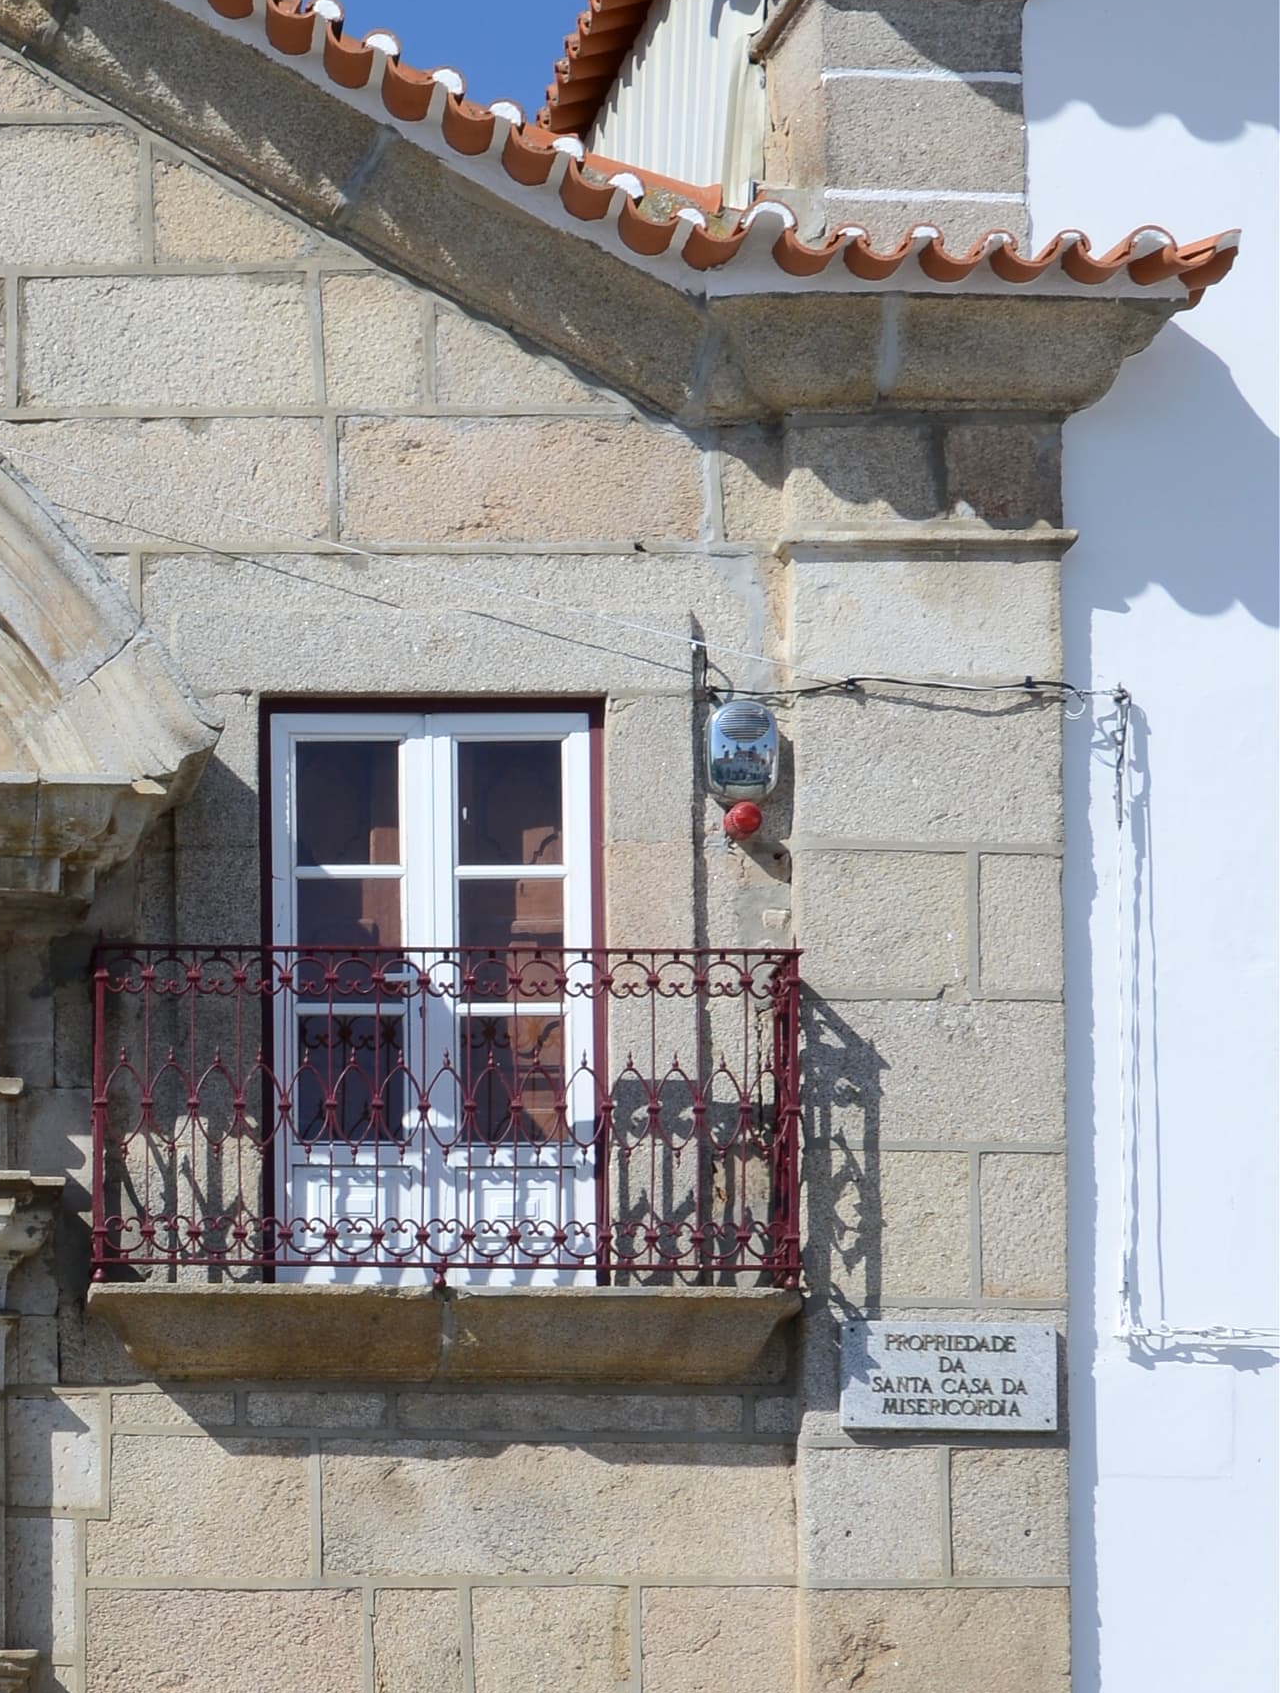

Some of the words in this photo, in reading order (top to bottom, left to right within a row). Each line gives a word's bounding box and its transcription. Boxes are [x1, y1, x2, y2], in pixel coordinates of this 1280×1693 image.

[884, 1334, 1017, 1353] PROPRIEDADE
[939, 1356, 967, 1374] DA
[872, 1376, 934, 1394] SANTA
[941, 1378, 995, 1396] CASA
[1001, 1378, 1028, 1395] DA
